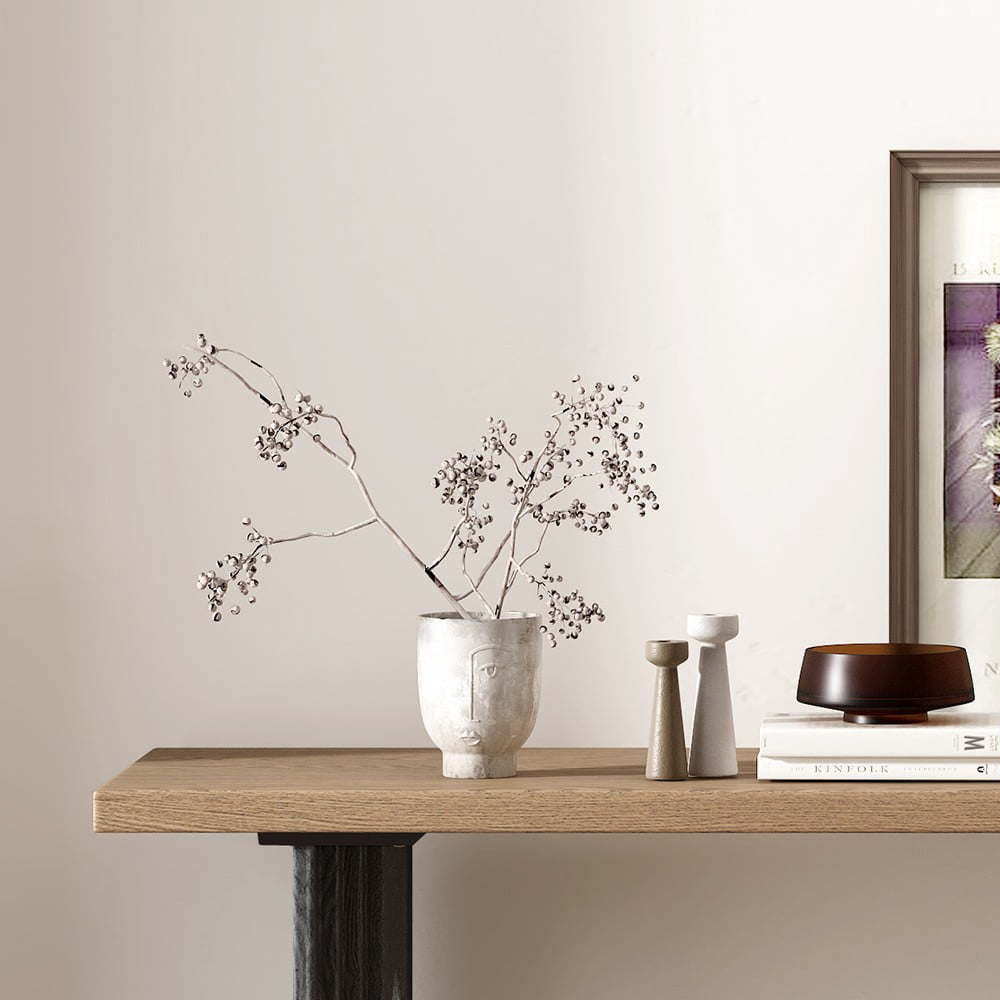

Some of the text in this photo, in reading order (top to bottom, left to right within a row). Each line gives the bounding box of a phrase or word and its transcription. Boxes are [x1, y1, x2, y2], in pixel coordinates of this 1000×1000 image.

[952, 262, 968, 276] 15
[963, 735, 985, 751] M
[814, 764, 890, 774] KINFOLK
